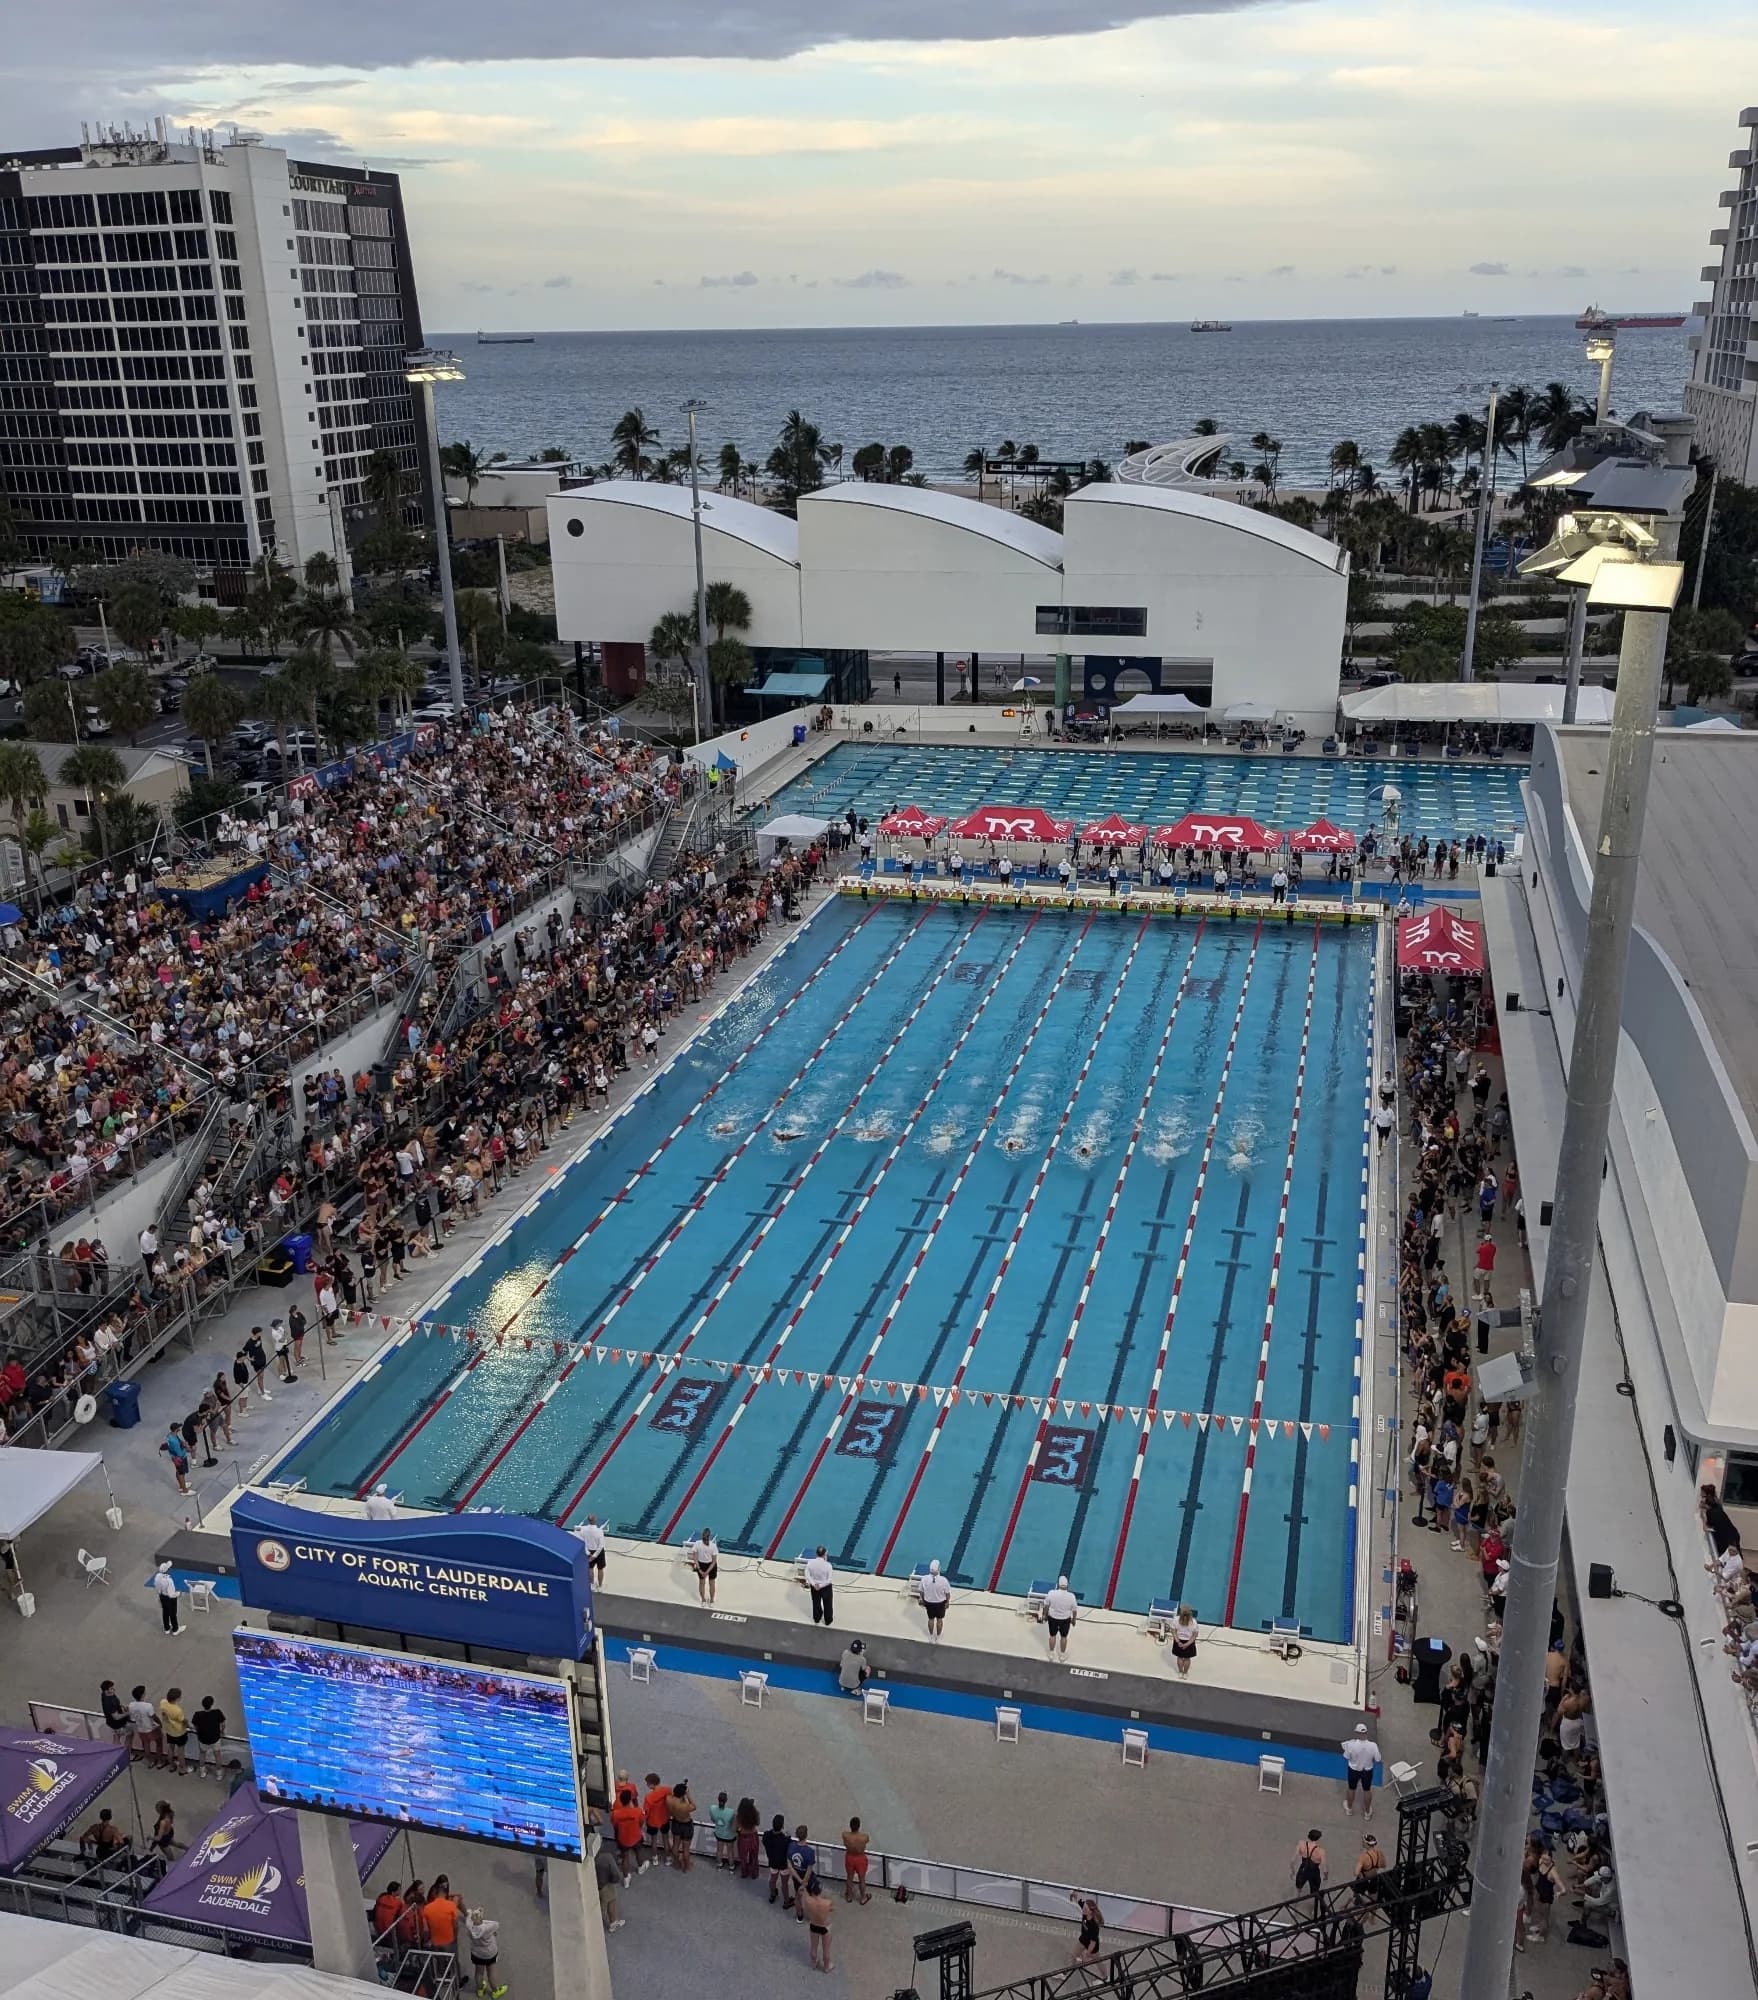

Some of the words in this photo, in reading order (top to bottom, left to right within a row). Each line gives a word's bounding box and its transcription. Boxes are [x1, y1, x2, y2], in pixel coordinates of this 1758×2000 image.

[289, 174, 350, 196] COURTYARD
[896, 820, 924, 830] TYR
[985, 817, 1036, 834] TYR
[1191, 825, 1244, 843] TYR
[1098, 830, 1127, 840] TYR
[1308, 834, 1340, 845] TYR
[1422, 950, 1463, 965] TYR
[295, 1545, 336, 1564] CITY
[341, 1553, 367, 1568] OF
[372, 1557, 420, 1577] FORT
[425, 1565, 549, 1597] LAUDERDALE
[357, 1571, 424, 1592] AQUATIC
[429, 1582, 488, 1602] CENTER
[7, 1787, 33, 1813] SWIM
[14, 1792, 40, 1819] FORT
[22, 1771, 78, 1824] LAUDERDALE
[209, 1874, 238, 1886] SWIM
[204, 1884, 234, 1896] FORT
[198, 1894, 272, 1916] LAUDERDALE
